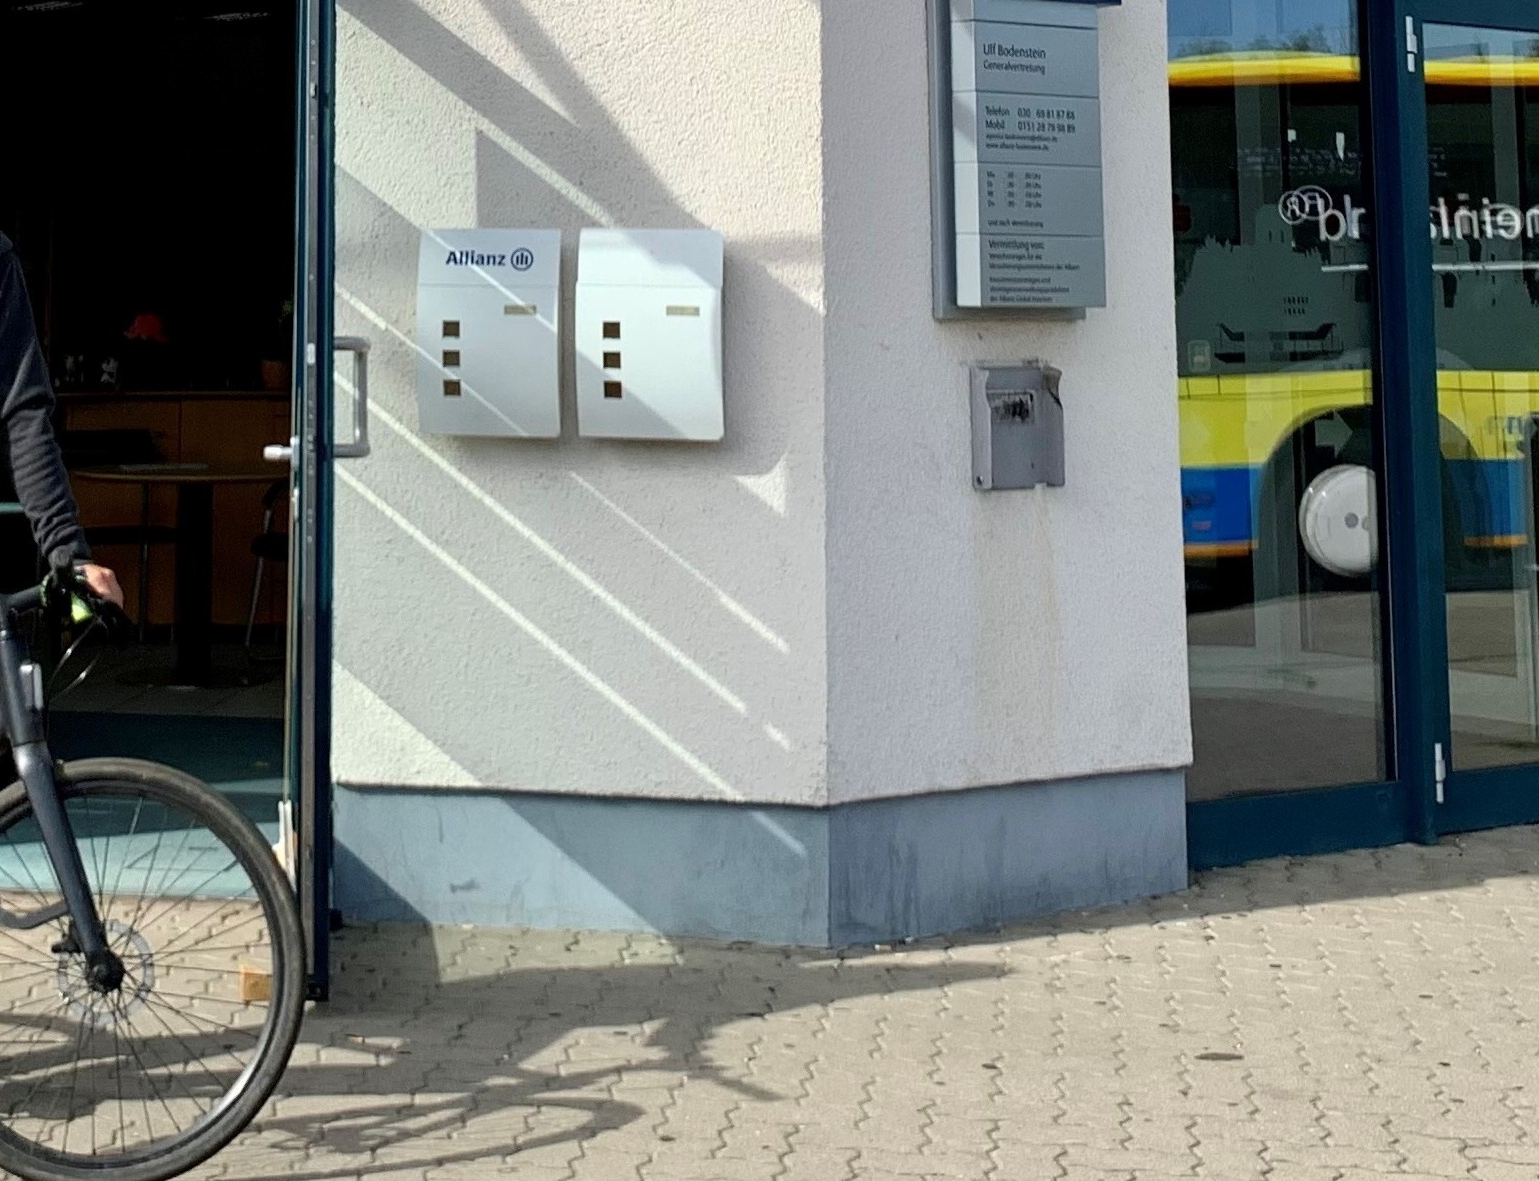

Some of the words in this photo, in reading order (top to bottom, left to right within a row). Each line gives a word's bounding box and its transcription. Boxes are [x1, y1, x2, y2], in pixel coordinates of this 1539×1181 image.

[983, 43, 996, 55] Ulf
[998, 44, 1046, 59] Bodenstein
[983, 60, 1045, 75] Generalvertretung
[985, 105, 1010, 117] Telefon
[985, 119, 1005, 130] Mobil
[446, 250, 506, 267] Allianz
